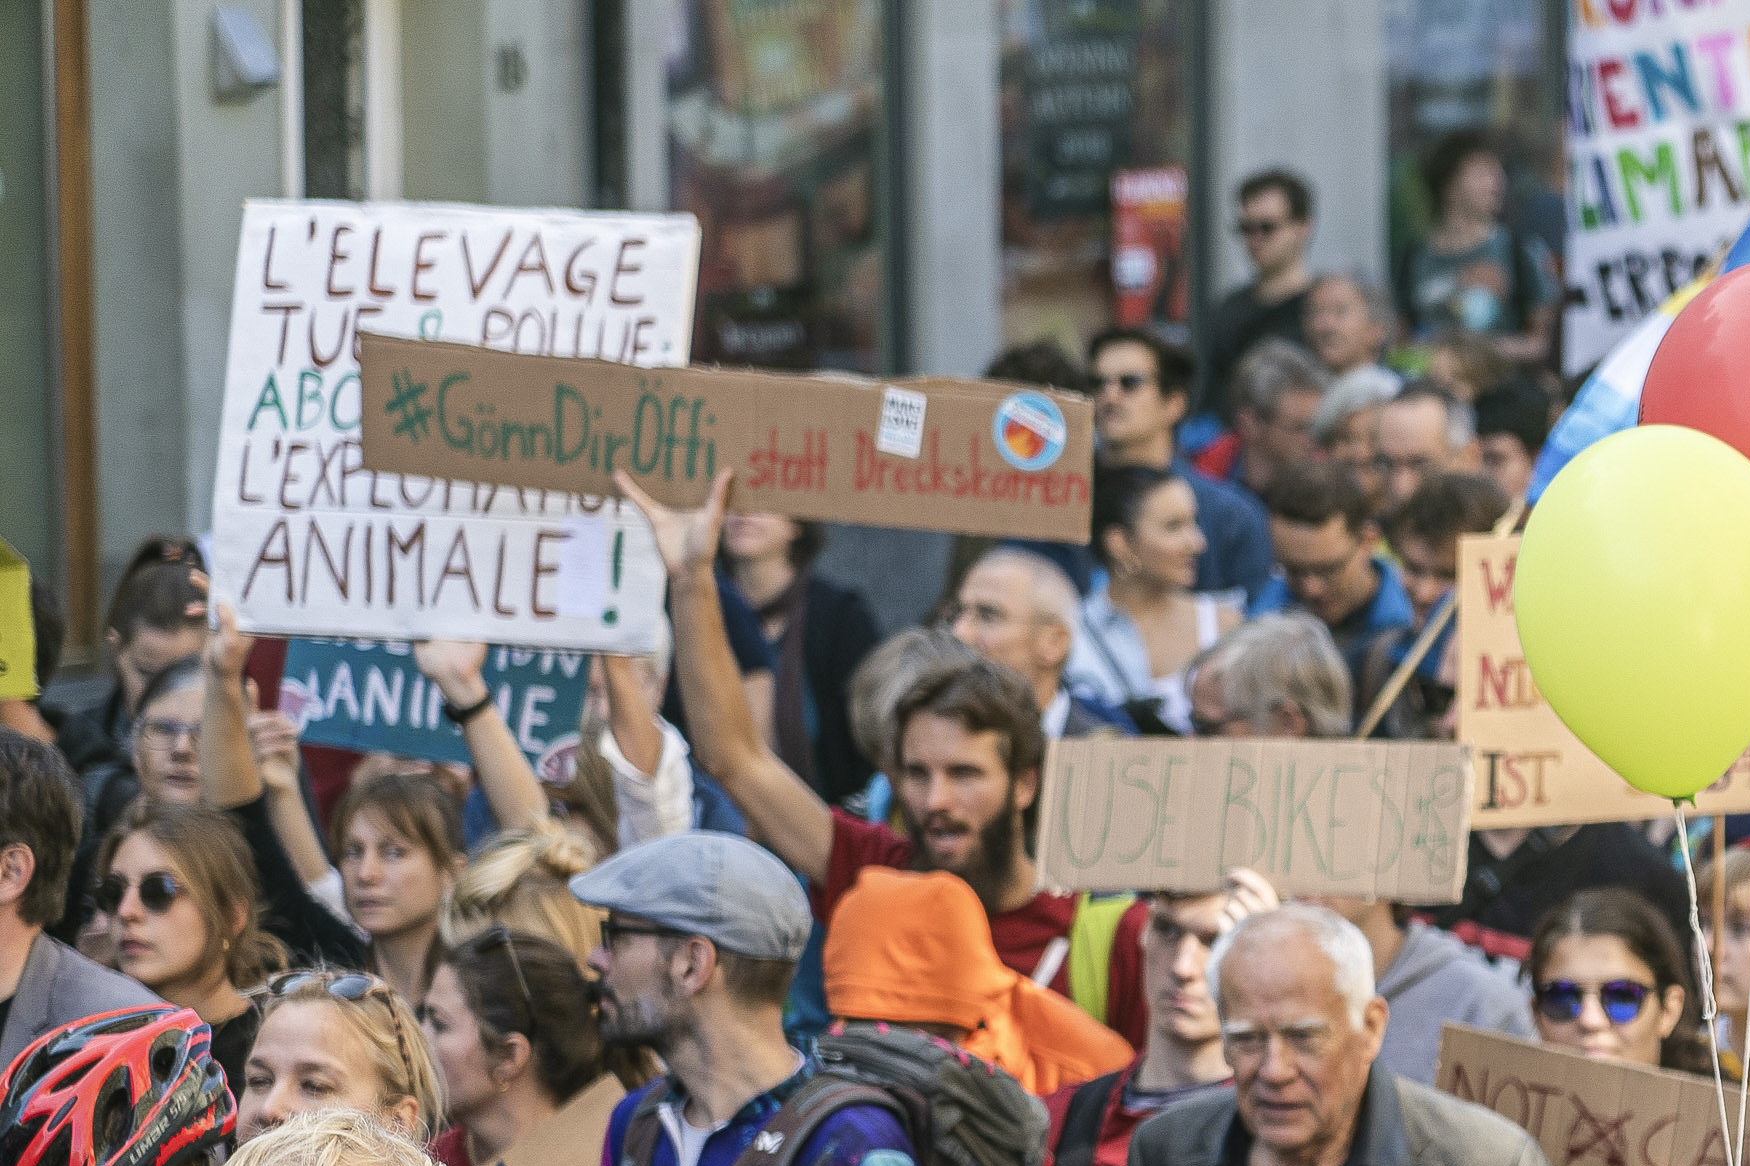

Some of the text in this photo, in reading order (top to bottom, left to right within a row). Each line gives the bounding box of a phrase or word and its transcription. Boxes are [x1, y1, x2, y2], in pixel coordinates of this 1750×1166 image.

[263, 215, 648, 308] L'ELEVAGE
[241, 519, 626, 627] ANIMALE !
[1061, 756, 1402, 881] USE BIKES
